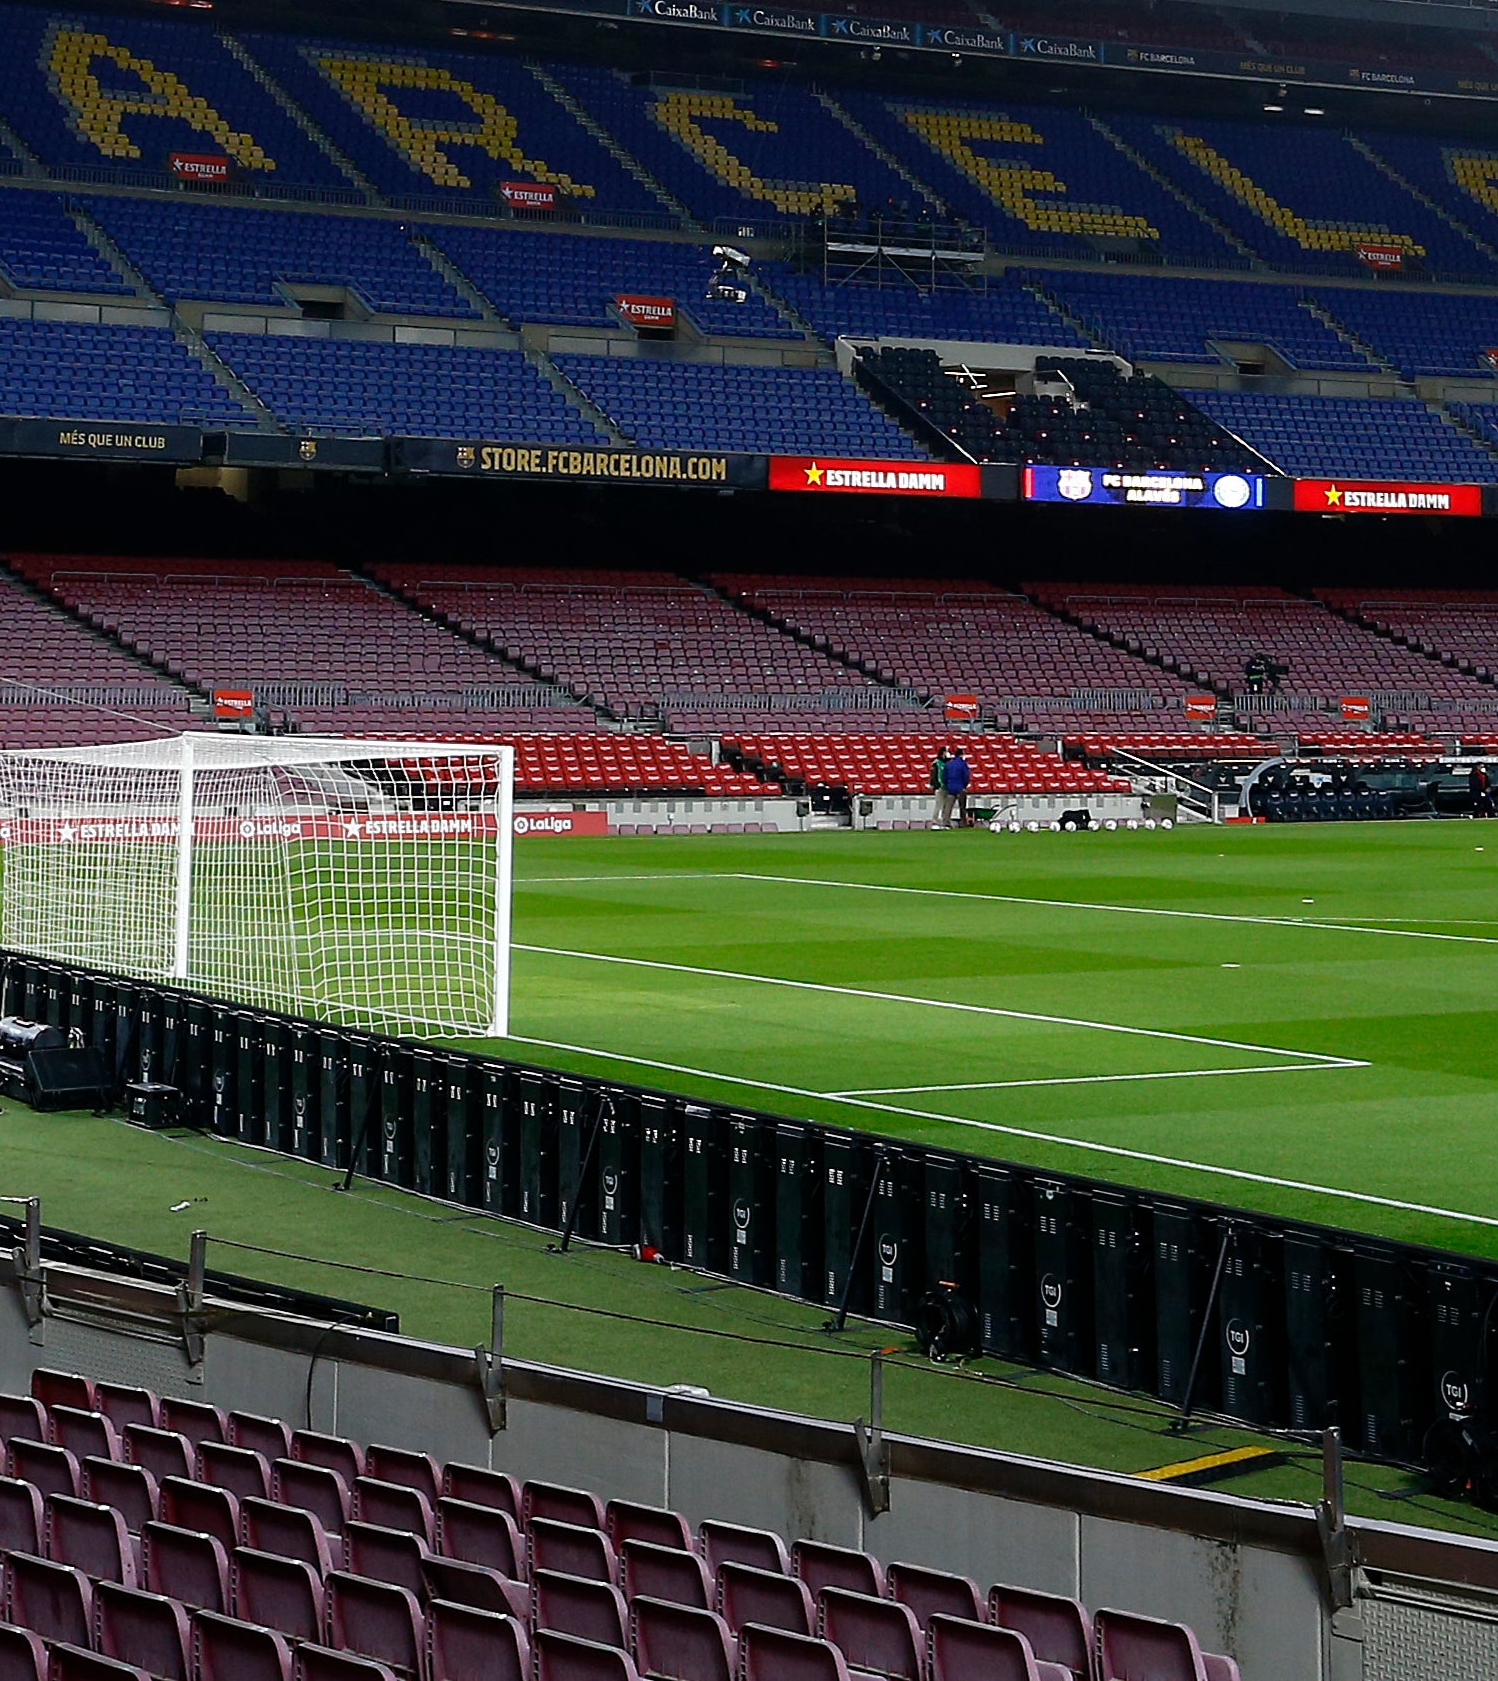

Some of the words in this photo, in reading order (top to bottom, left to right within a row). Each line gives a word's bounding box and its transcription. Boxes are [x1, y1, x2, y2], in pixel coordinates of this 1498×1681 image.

[655, 0, 717, 21] CaixaBank
[753, 11, 815, 31] CaixaBank
[850, 20, 910, 41] CaixaBank
[945, 31, 1004, 50] CaixaBank
[1037, 38, 1096, 59] CaixaBank
[1140, 52, 1150, 62] FC
[1152, 53, 1195, 65] BARCELONA
[1361, 71, 1371, 80] FC
[1373, 72, 1414, 84] BARCELONA
[184, 162, 226, 174] ESTRELLA
[513, 190, 553, 202] ESTRELLA
[1368, 253, 1401, 263] ESTRELLA
[630, 304, 672, 316] ESTRELLA
[59, 431, 85, 445] MÉS
[88, 434, 113, 447] QUE
[116, 435, 133, 447] UN
[135, 436, 165, 449] CLUB
[481, 446, 726, 480] STORE.FCBARCELONA.COM
[826, 469, 897, 489] ESTRELLA
[899, 472, 944, 490] DAMM
[1102, 475, 1120, 487] FC
[1121, 476, 1203, 490] BARCELONA
[1344, 491, 1405, 506] ESTRELLA
[1407, 493, 1449, 508] DAMM
[81, 824, 150, 838] ESTRELLA
[256, 823, 301, 836] LaLiga
[366, 819, 429, 834] ESTRELLA
[431, 818, 471, 832] DAMM
[529, 818, 571, 832] LaLiga
[1044, 1284, 1057, 1298] TGI
[1230, 1330, 1244, 1344] TGI
[1445, 1383, 1462, 1399] TGI
